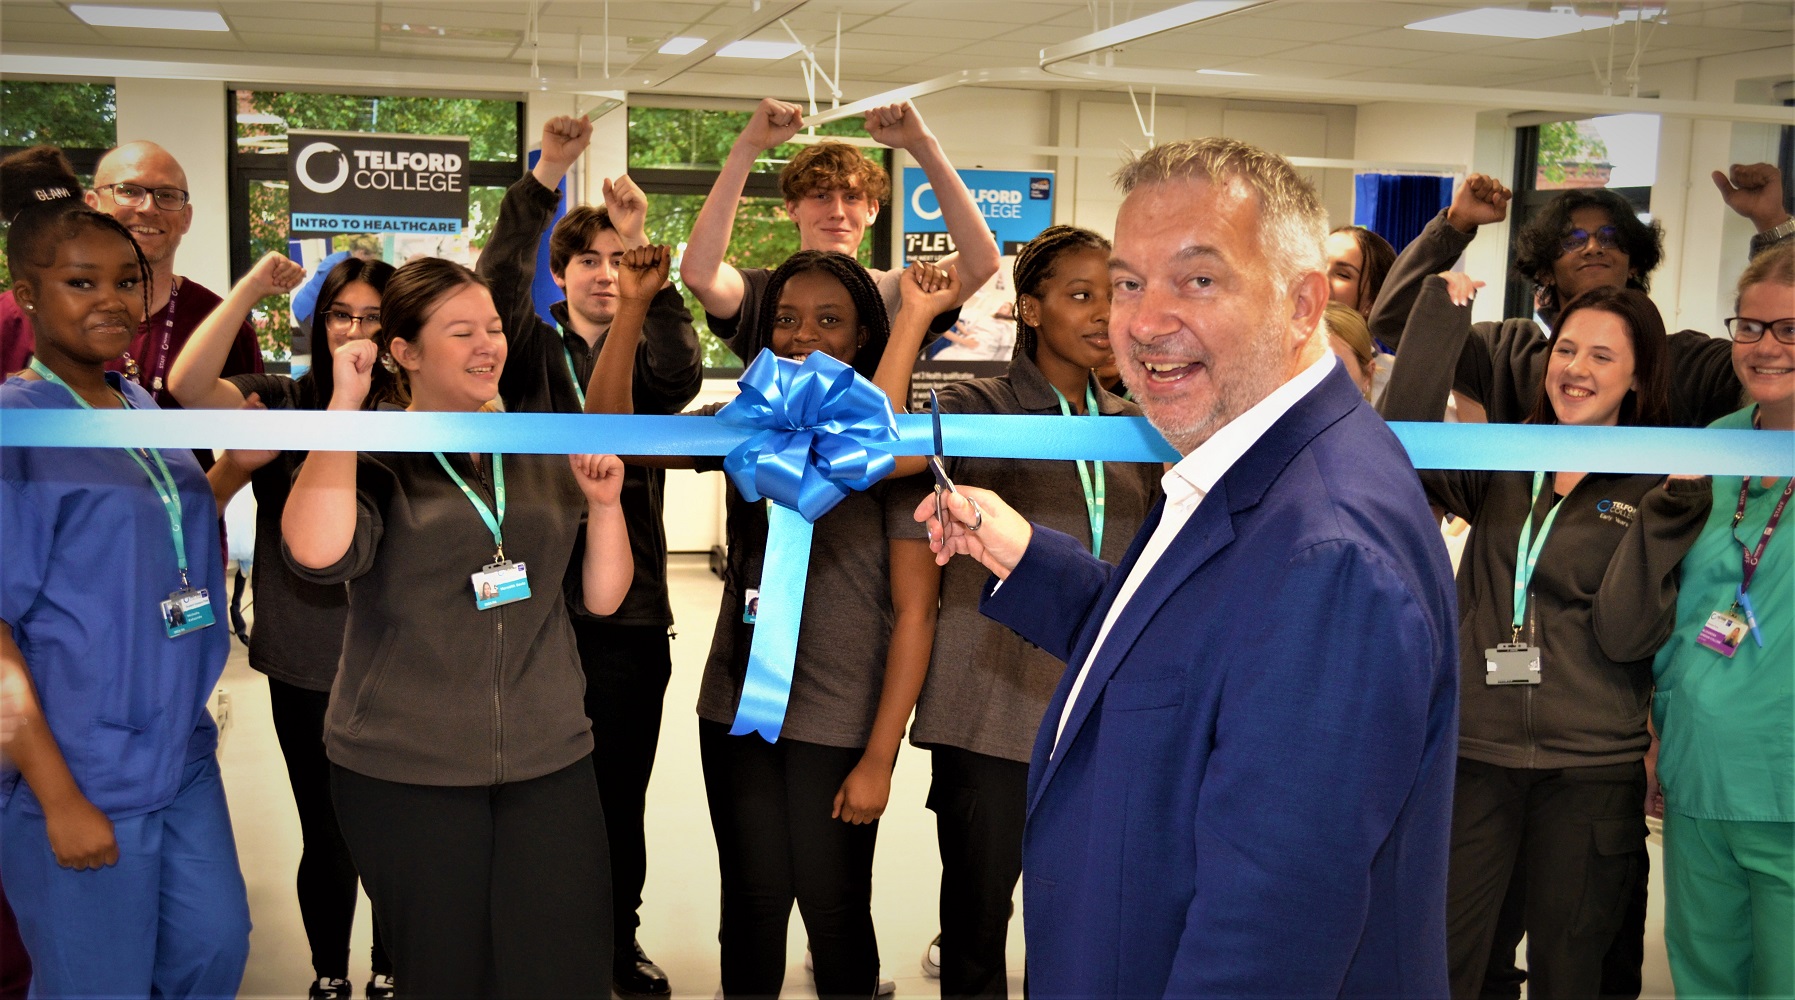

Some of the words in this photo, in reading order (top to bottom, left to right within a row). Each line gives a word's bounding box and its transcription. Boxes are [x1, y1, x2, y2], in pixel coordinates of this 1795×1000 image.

[353, 150, 462, 172] TELFORD
[353, 170, 462, 192] COLLEGE
[35, 187, 71, 201] GLAM
[970, 189, 1023, 204] LFORD
[982, 203, 1023, 219] LEGE
[295, 218, 339, 229] INTRO
[342, 219, 360, 229] TO
[364, 220, 456, 232] HEALTHCARE
[905, 233, 957, 252] T-LEV
[1773, 501, 1784, 518] STAFF
[1600, 513, 1612, 521] Early
[1615, 516, 1629, 527] Years
